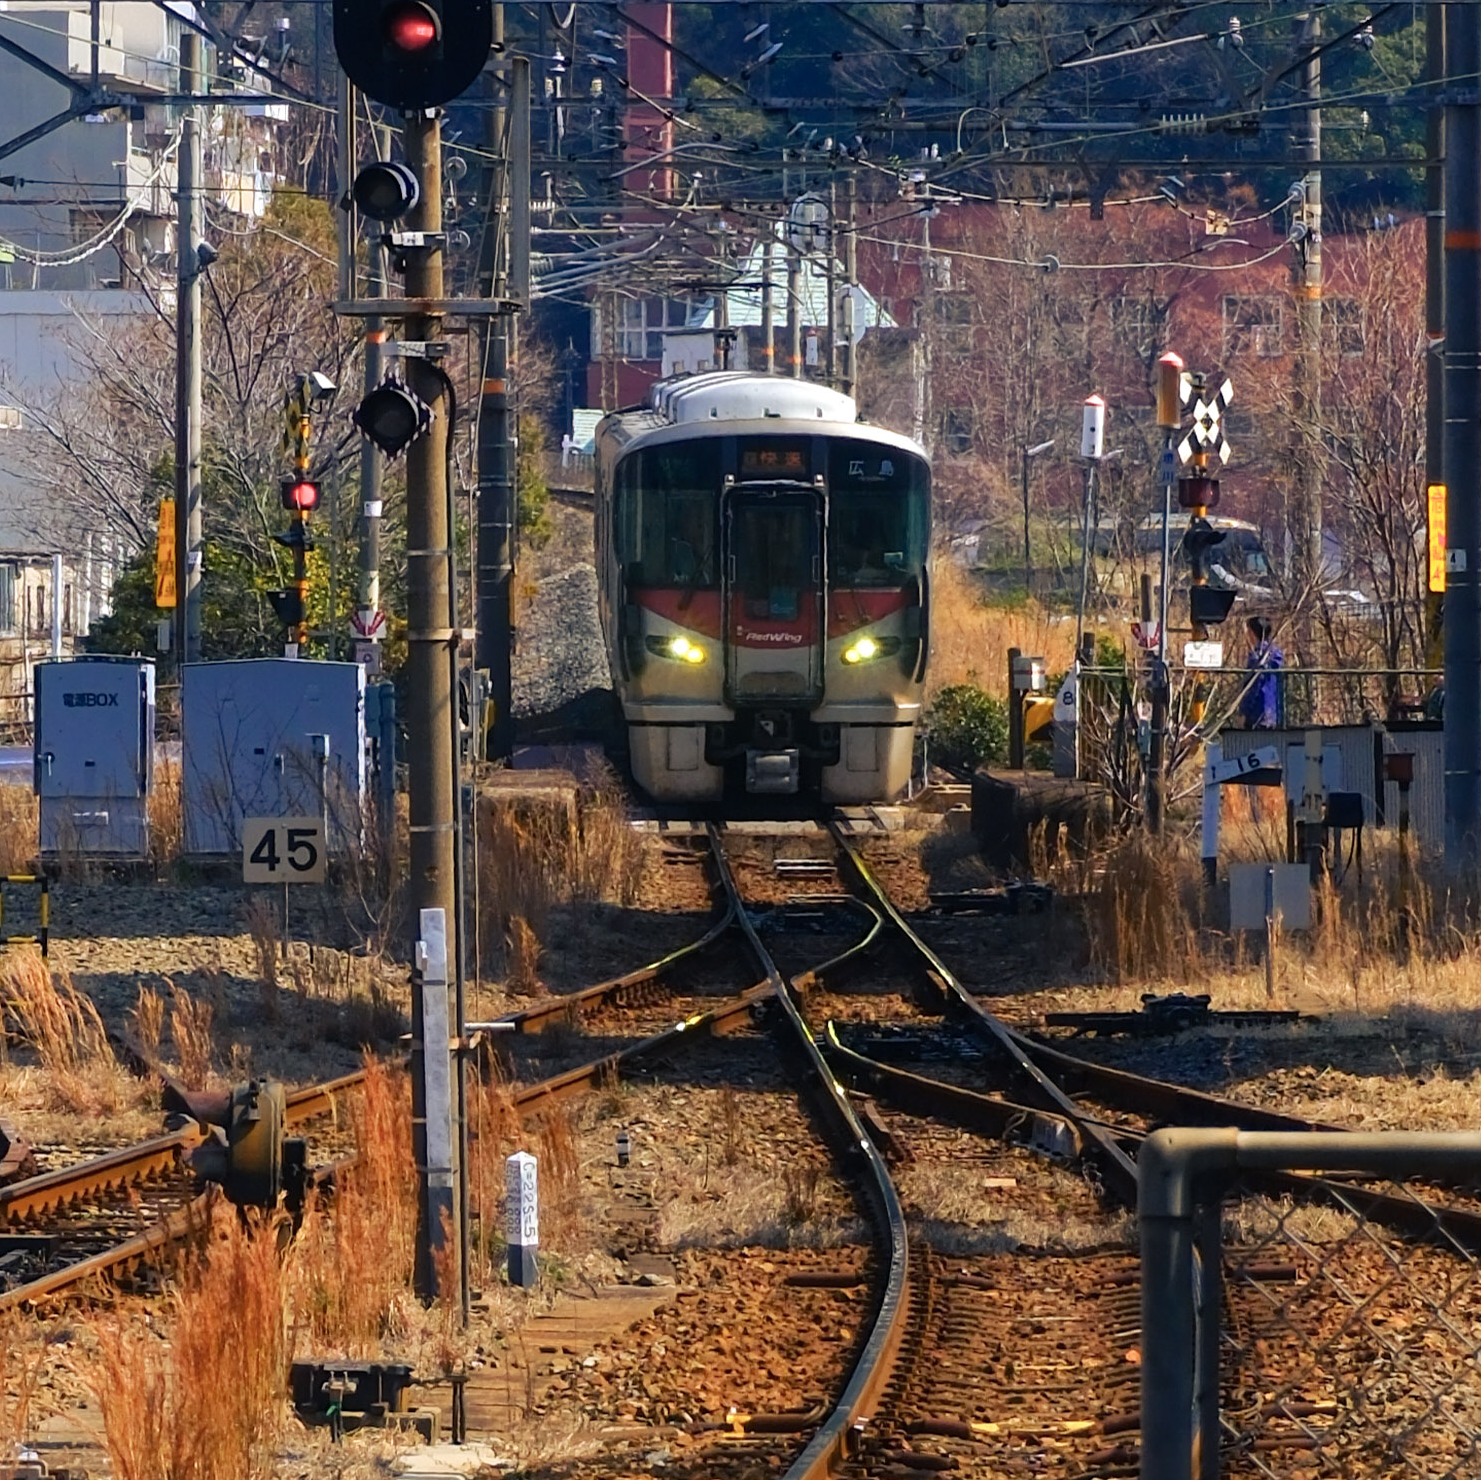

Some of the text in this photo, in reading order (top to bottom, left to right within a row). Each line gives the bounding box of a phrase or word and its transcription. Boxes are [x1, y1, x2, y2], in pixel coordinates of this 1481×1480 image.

[849, 459, 894, 476] 広島
[1062, 691, 1074, 706] 8
[1237, 752, 1261, 772] 16
[249, 828, 319, 872] 45
